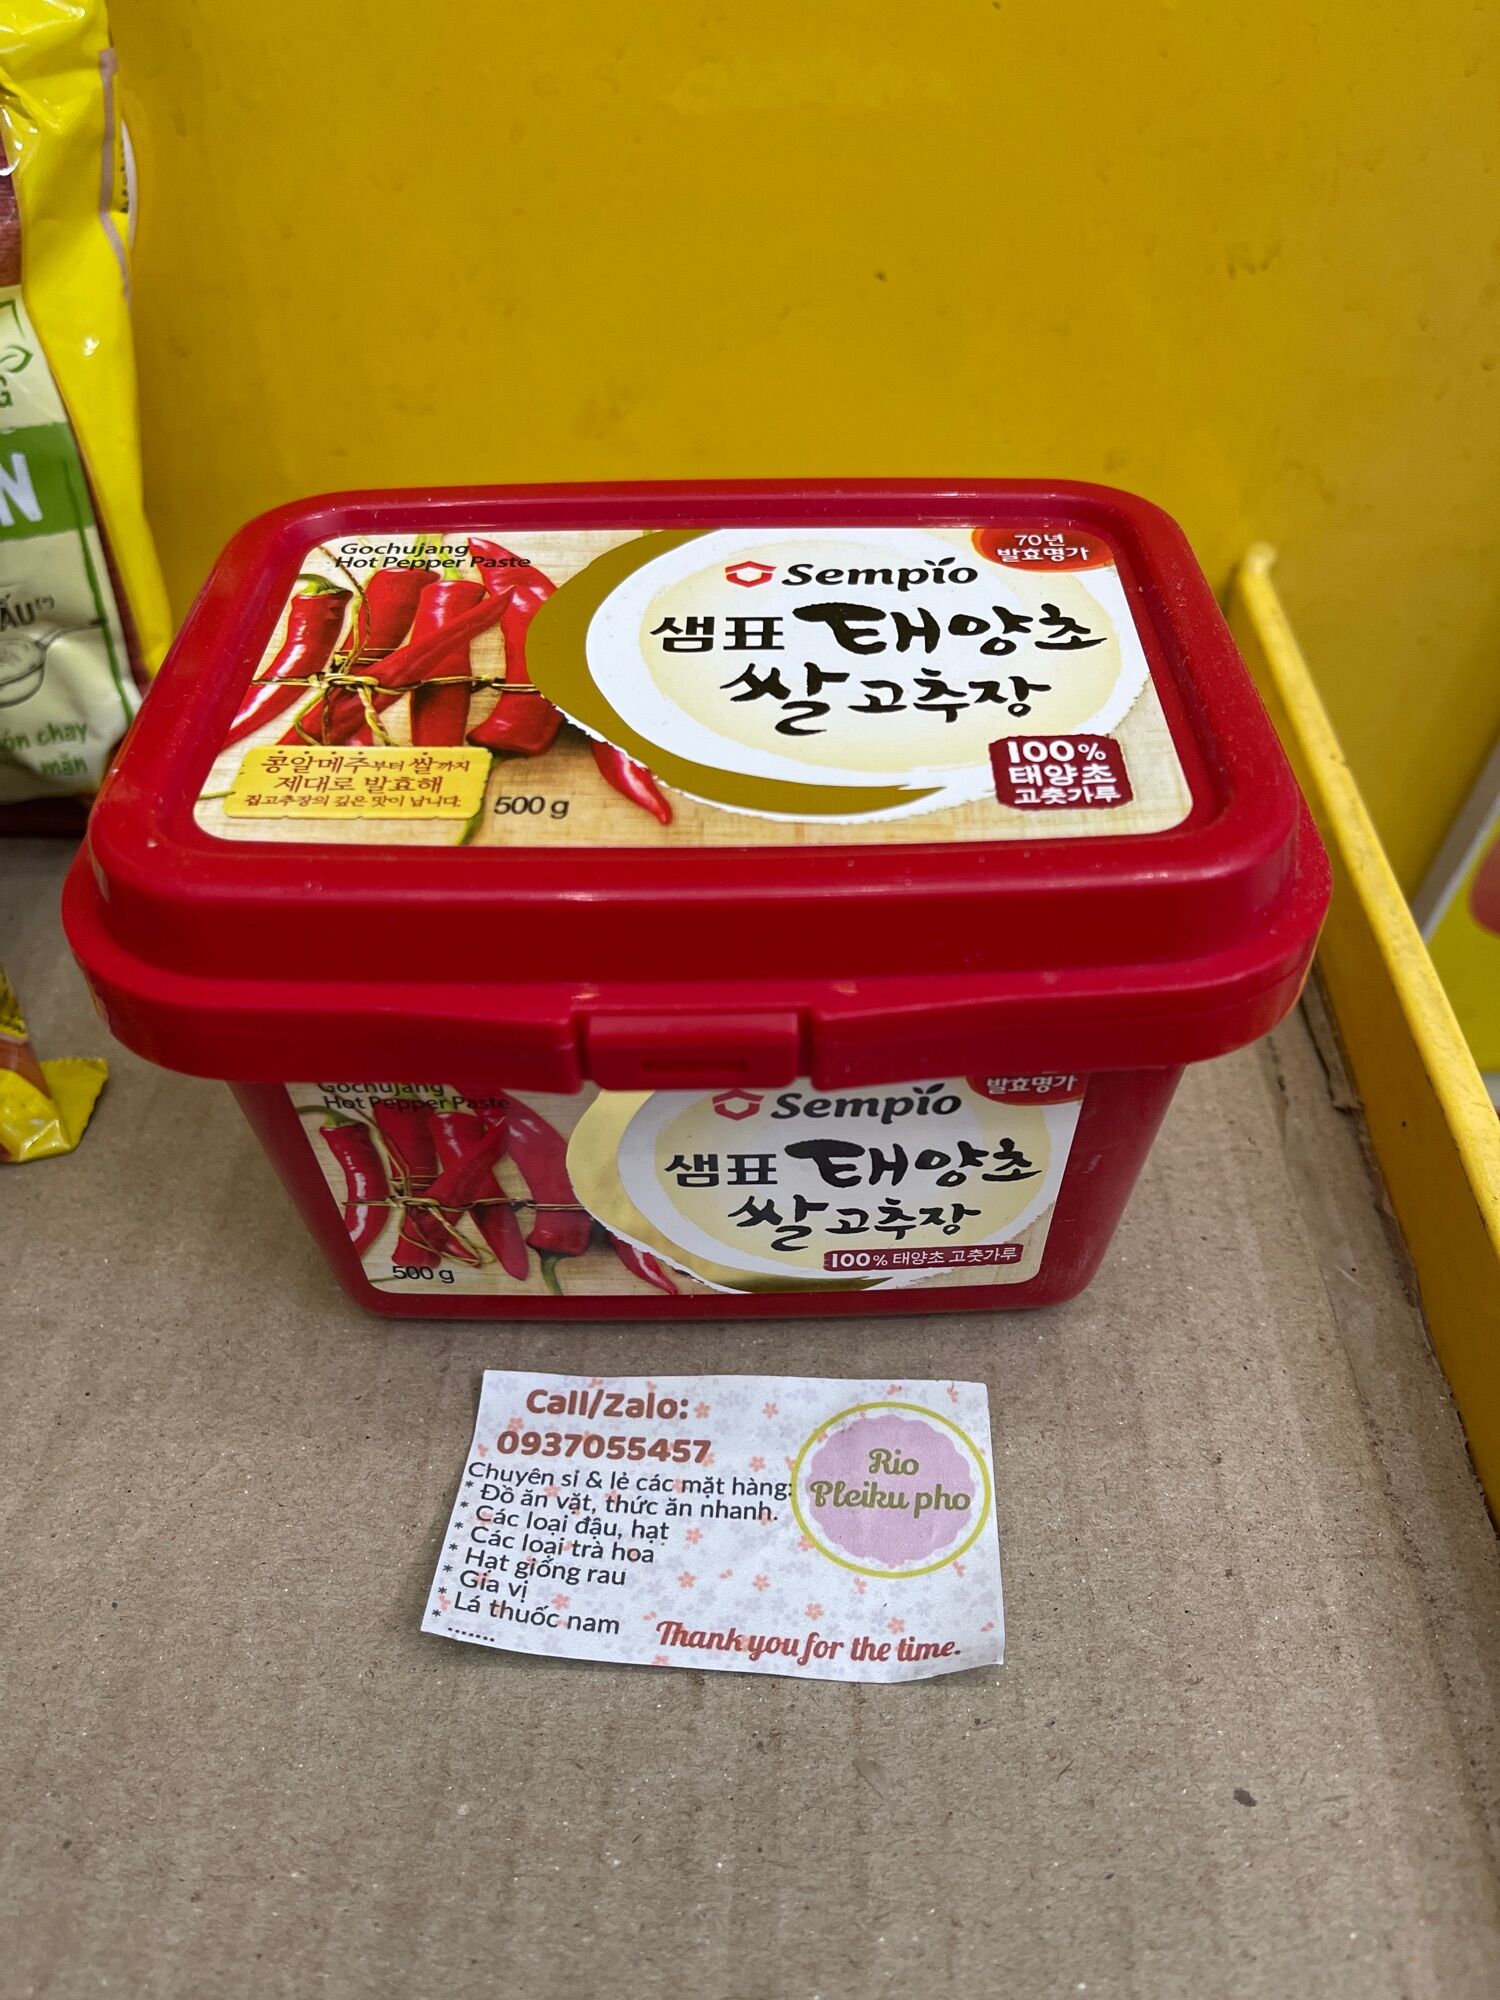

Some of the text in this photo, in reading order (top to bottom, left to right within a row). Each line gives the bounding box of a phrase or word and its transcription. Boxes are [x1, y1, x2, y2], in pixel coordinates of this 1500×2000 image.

[341, 542, 469, 557] Gochujang
[997, 547, 1089, 563] 발효명가
[1014, 534, 1065, 547] 70년
[335, 556, 531, 571] Hot Pepper Paste
[781, 557, 979, 592] Sempio
[650, 602, 1108, 656] 샘표 태양초
[719, 662, 1052, 736] 쌀 고추장
[1007, 740, 1107, 764] 100%
[274, 775, 443, 794] 제대로 발효해
[1008, 763, 1118, 786] 태양초
[494, 796, 570, 819] 500 g
[1014, 786, 1122, 804] 고춧가루
[987, 1075, 1077, 1095] 발효명가
[323, 1096, 510, 1112] Hot Pepper Paste
[771, 1083, 962, 1124] Sempio
[664, 1138, 1042, 1188] 샘표 태양초
[727, 1194, 982, 1251] 쌀 고추장
[392, 1265, 455, 1283] 500 g
[832, 1247, 1017, 1268] 100% 태양초 고춧가루
[526, 1388, 688, 1420] Call/Zalo:
[497, 1430, 712, 1464] 0937055457
[868, 1447, 920, 1476] Rio
[468, 1461, 554, 1487] Chuyên
[586, 1471, 602, 1489] &
[636, 1474, 674, 1493] các
[681, 1476, 725, 1498] mặt
[732, 1477, 793, 1501] hàng:
[480, 1483, 515, 1504] Đồ
[520, 1489, 548, 1508] ăn
[605, 1494, 659, 1515] thức
[665, 1498, 692, 1517] ăn
[700, 1500, 778, 1521] nhanh.
[810, 1480, 972, 1519] Pleiku pho
[475, 1505, 669, 1544] Các loại đậu, hạt
[470, 1526, 655, 1563] Các loại trà hoa
[464, 1547, 626, 1586] Hạt giống rau
[459, 1570, 528, 1603] Gia vị
[454, 1591, 620, 1635] Lá thuốc nam
[656, 1620, 961, 1667] Thank you for the time.
